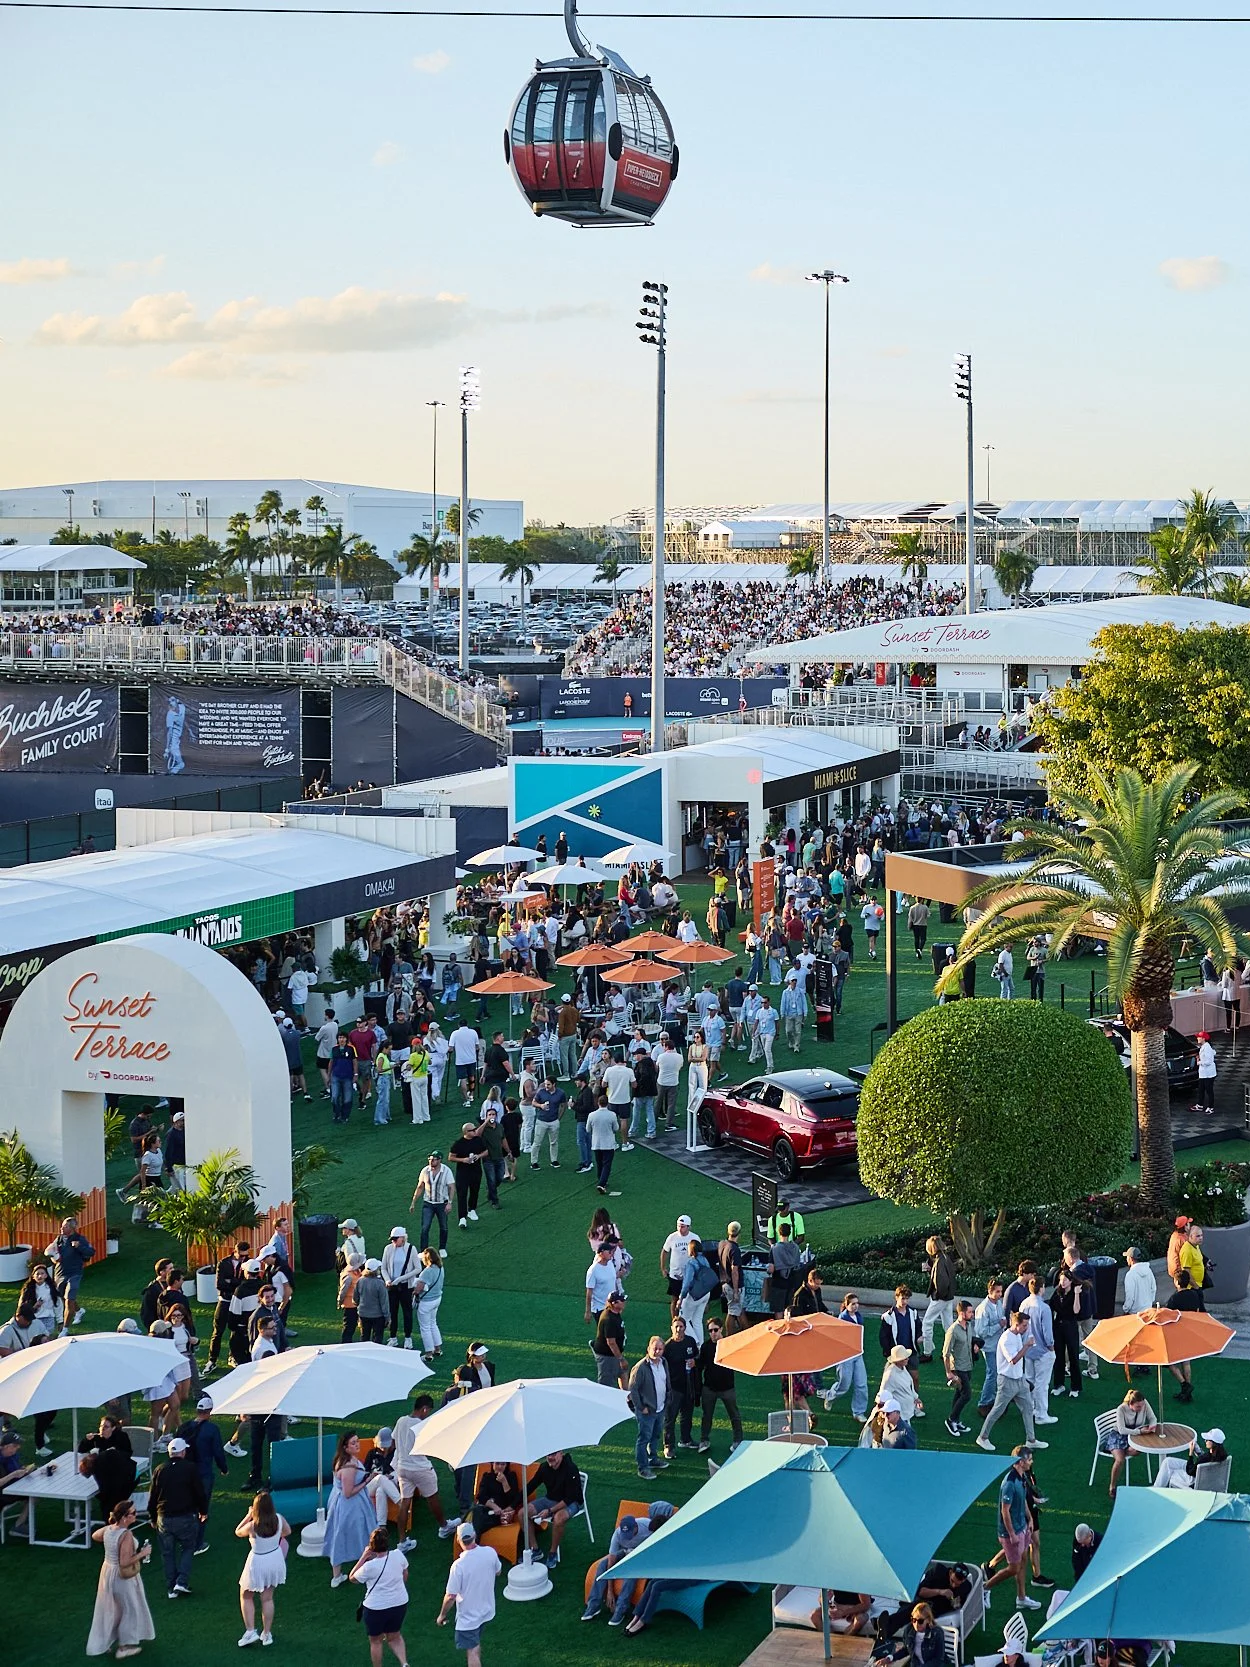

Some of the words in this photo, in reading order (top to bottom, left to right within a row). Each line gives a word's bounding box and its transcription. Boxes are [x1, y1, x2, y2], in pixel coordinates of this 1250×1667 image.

[880, 623, 934, 647] Sunset
[934, 622, 991, 645] Terrace
[559, 687, 591, 695] LACOSTE
[773, 693, 787, 703] itaú
[21, 738, 59, 766] FAMILY
[63, 722, 105, 749] COURT
[814, 771, 834, 790] MIAMI
[840, 765, 857, 784] SLICE
[96, 797, 112, 806] itaú
[365, 877, 395, 897] OMAKAI
[195, 913, 220, 924] TACOS
[63, 972, 157, 1022] Sunset
[70, 1021, 171, 1061] Terrace
[88, 1071, 98, 1080] by
[113, 1073, 154, 1082] DOORDASH
